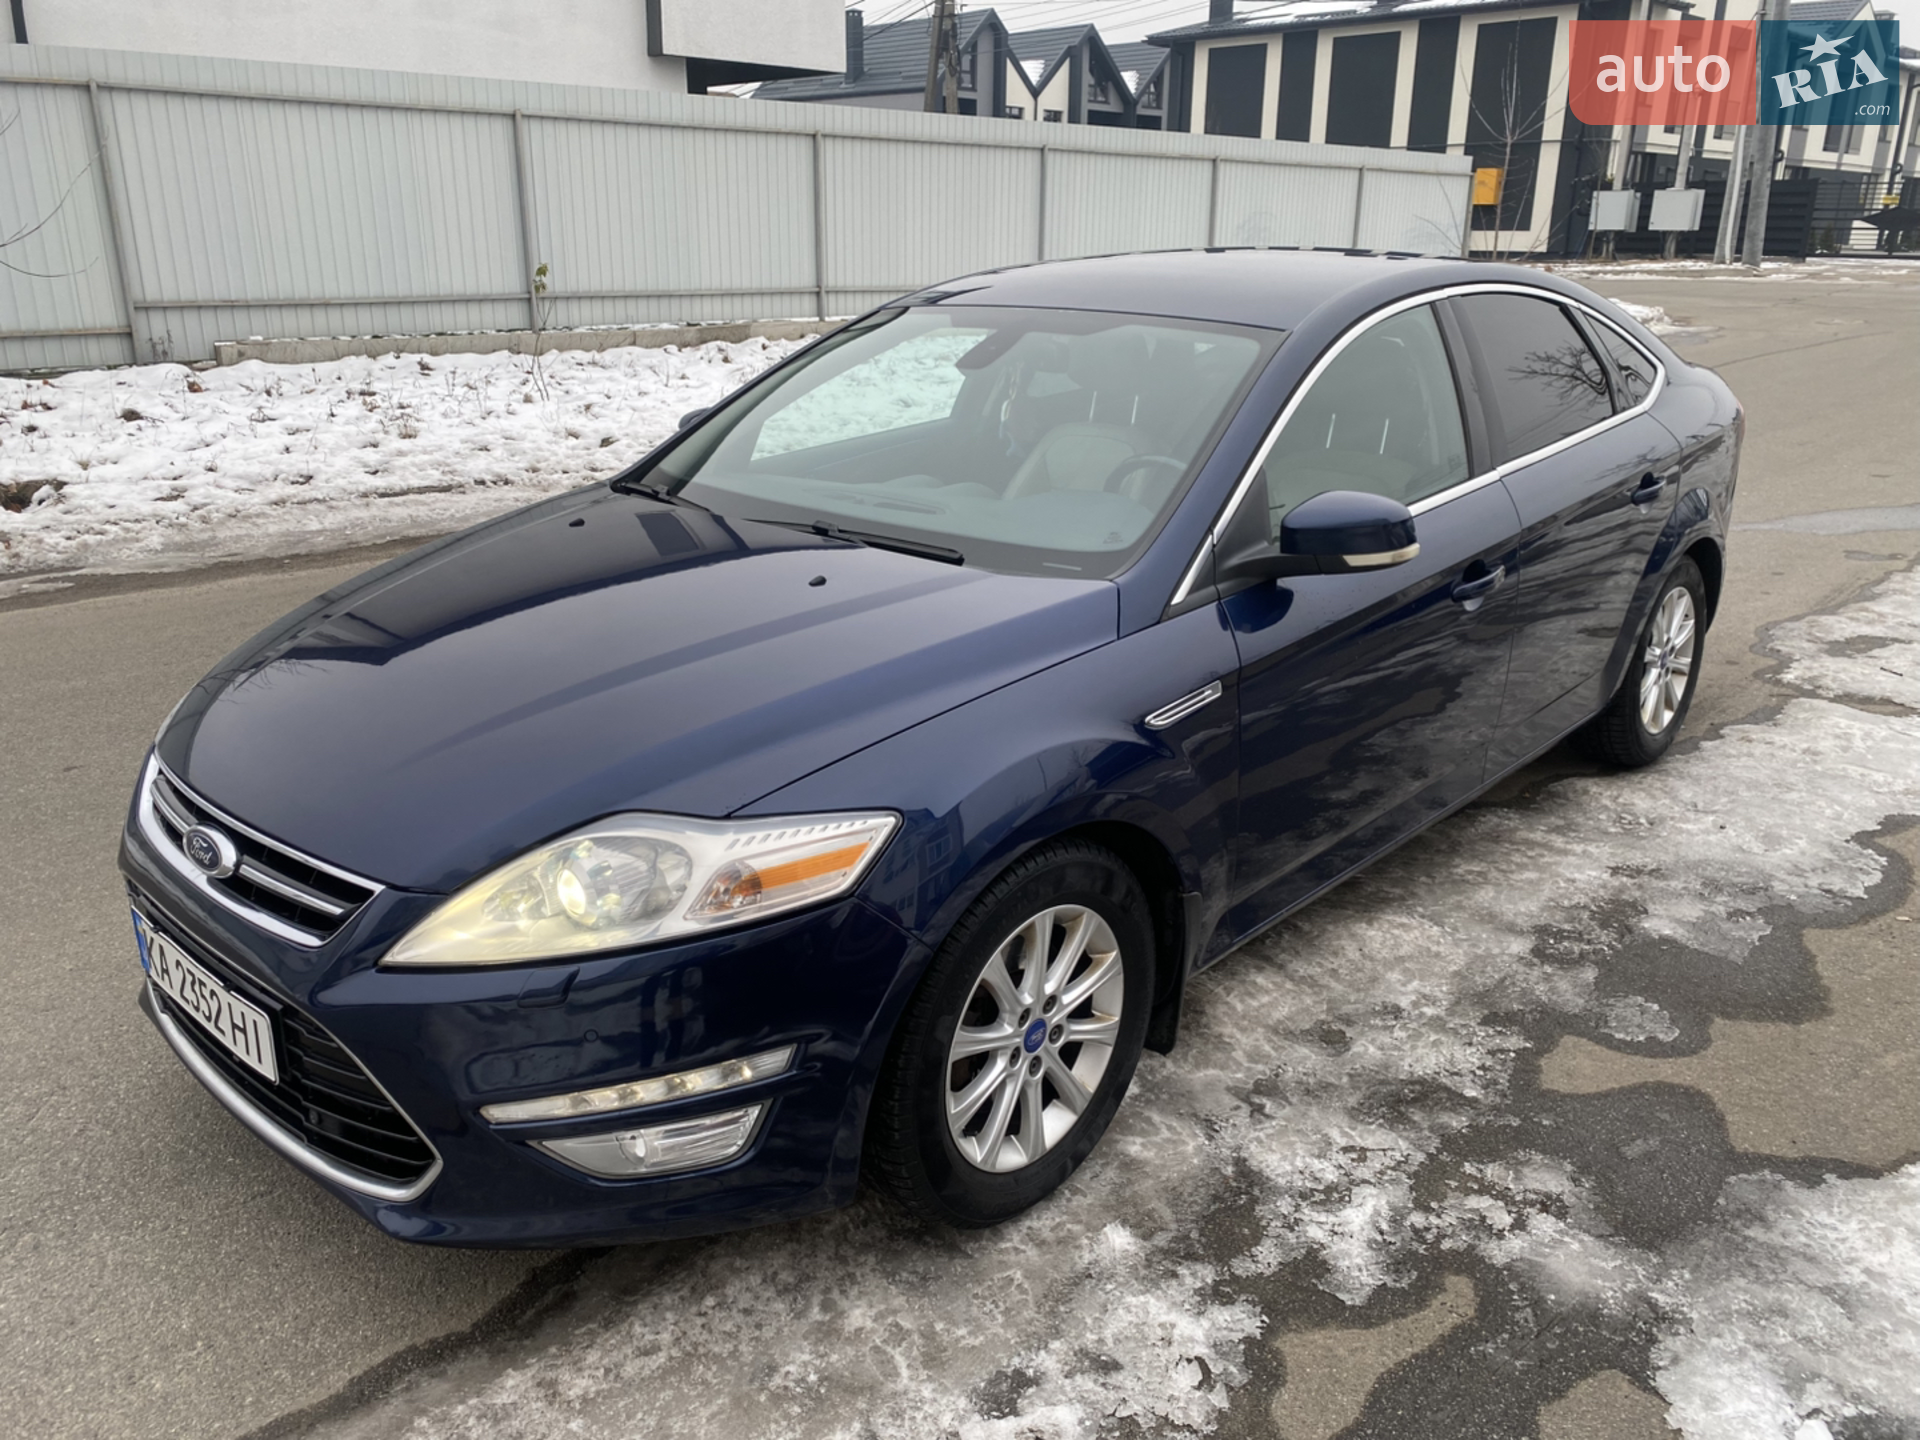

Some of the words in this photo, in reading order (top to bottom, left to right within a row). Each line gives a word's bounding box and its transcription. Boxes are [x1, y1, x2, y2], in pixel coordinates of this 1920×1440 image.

[190, 836, 213, 865] Ford
[175, 959, 226, 1037] 2352
[228, 1001, 263, 1066] HI
